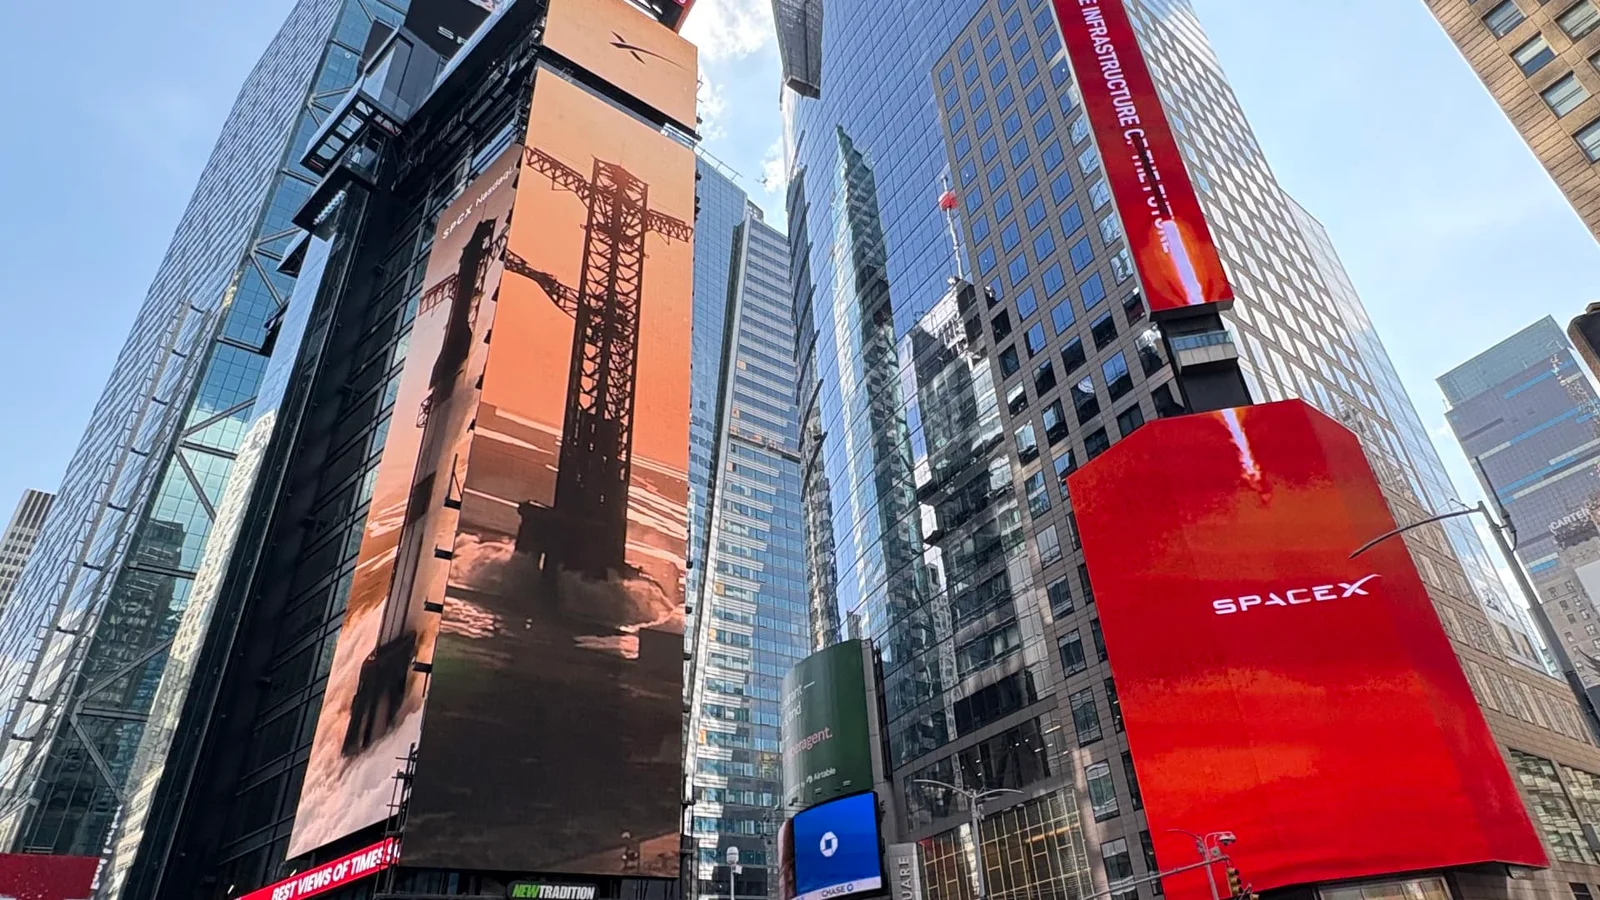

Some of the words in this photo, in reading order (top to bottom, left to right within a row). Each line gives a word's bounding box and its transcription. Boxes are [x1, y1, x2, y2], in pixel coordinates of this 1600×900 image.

[1082, 6, 1140, 127] INFRASTRUCTURE
[443, 204, 473, 239] SPCX
[1212, 574, 1383, 615] SPACEX
[271, 881, 298, 900] BEST
[298, 871, 332, 895] VIEWS
[332, 861, 350, 882] OF
[351, 846, 384, 875] TIMES
[821, 885, 846, 897] CHASE
